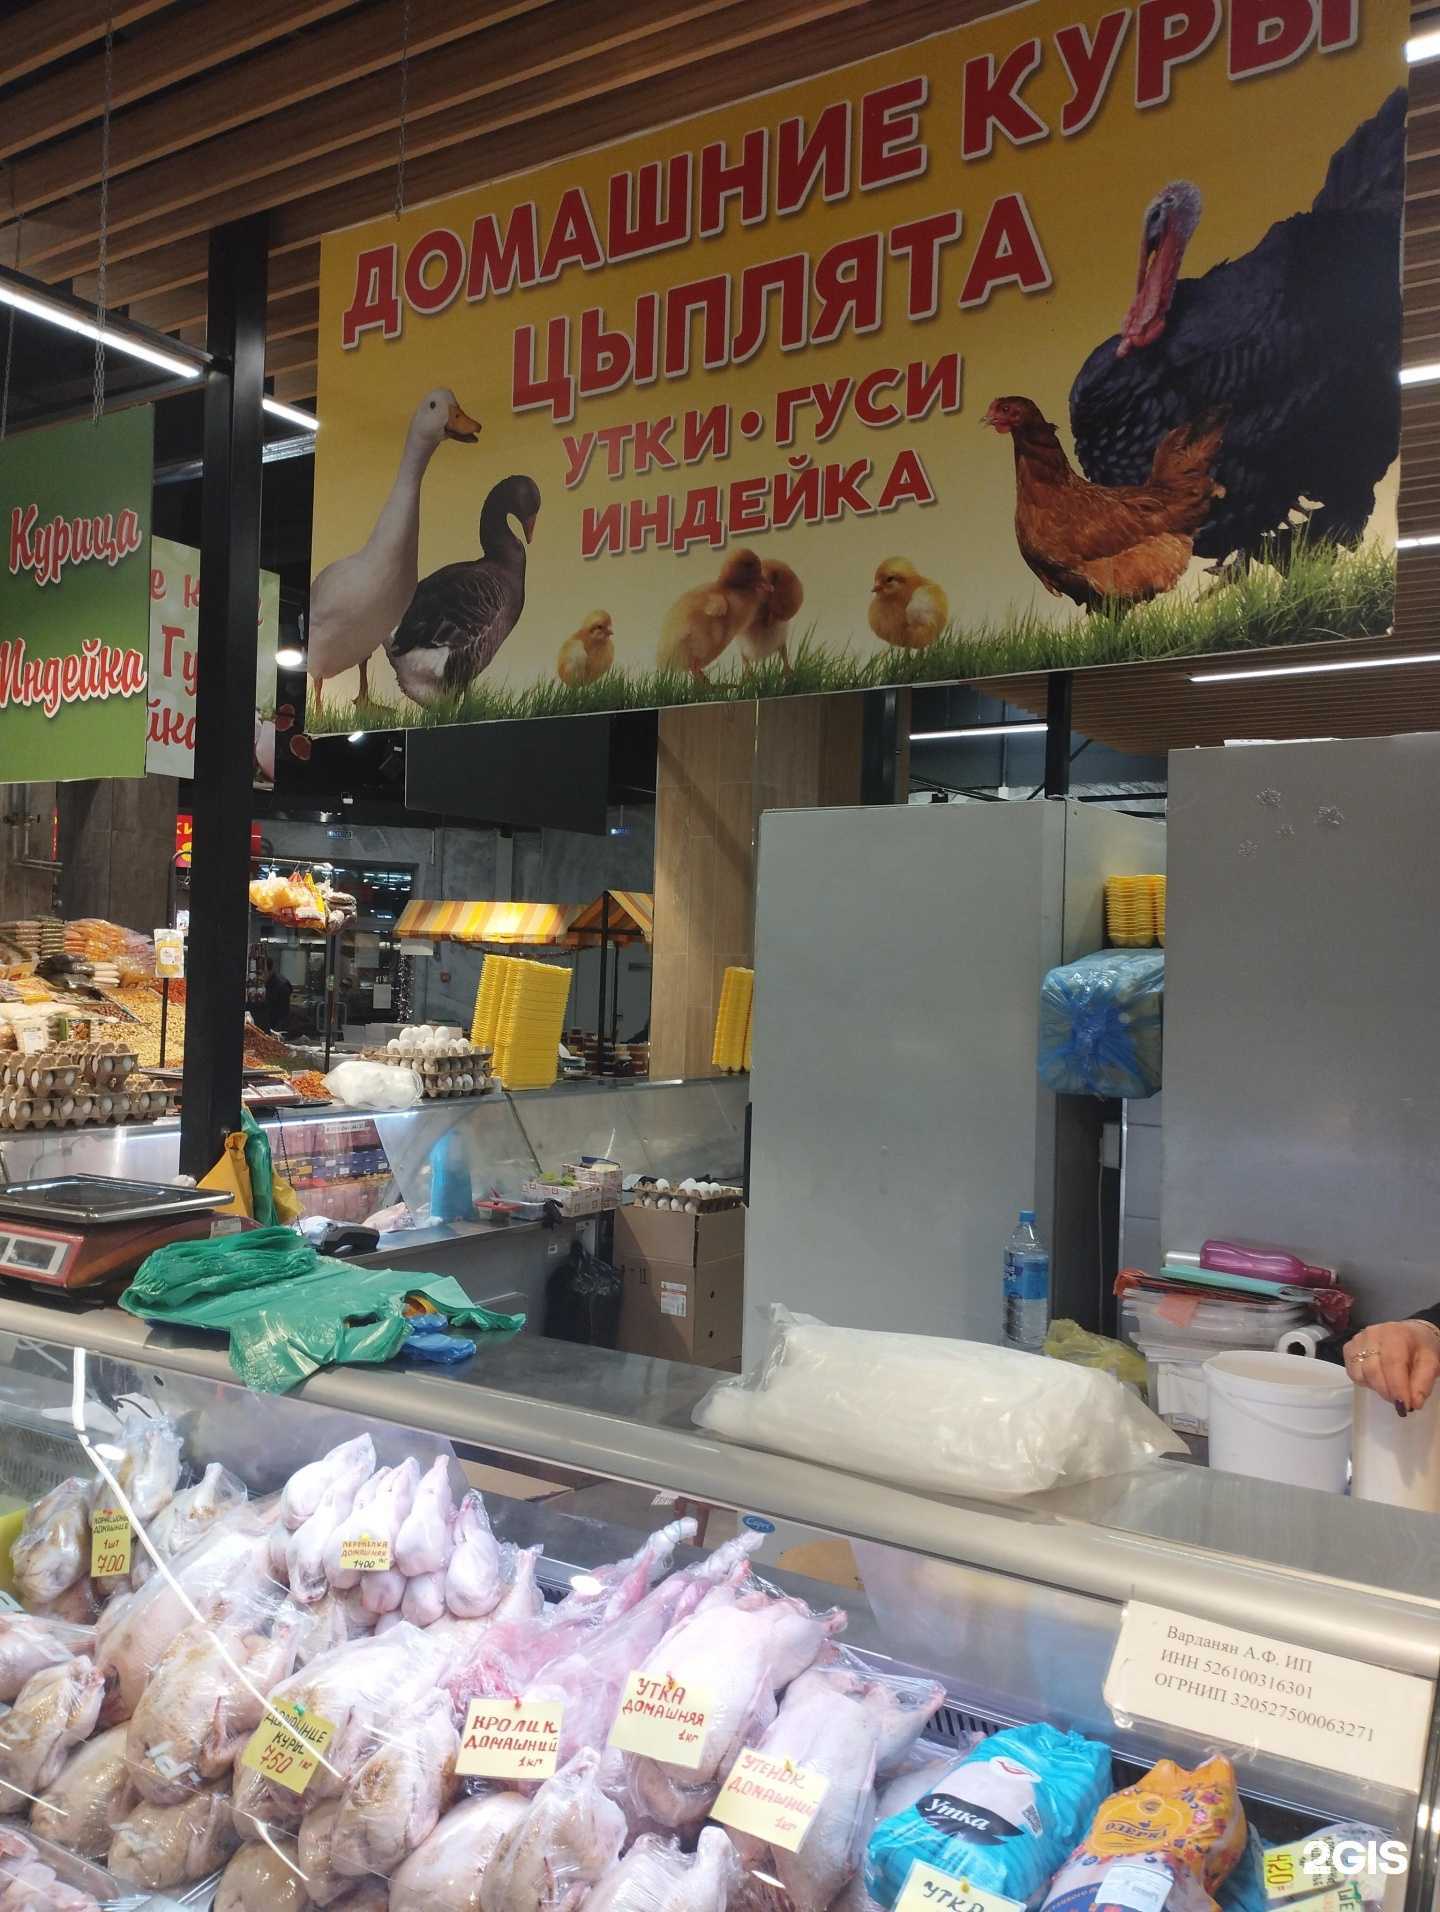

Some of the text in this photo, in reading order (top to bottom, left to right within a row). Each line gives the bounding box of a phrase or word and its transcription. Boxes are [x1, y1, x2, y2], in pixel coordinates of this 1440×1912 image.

[342, 0, 1359, 350] ДОМАШНИЕ КУРЫ
[512, 192, 1052, 423] ЦЫПЛЯТА
[562, 353, 963, 488] УТКИ ГУСИ
[581, 449, 936, 559] ИНДЕЙКА
[9, 504, 142, 586] Курица
[0, 638, 147, 719] Индейка
[98, 1554, 125, 1573] 700
[352, 1559, 376, 1569] 1400
[1167, 1625, 1313, 1674] Варданян А.Ф. ИП
[636, 1677, 686, 1705] УТКА
[1161, 1649, 1313, 1700] ИНН 526100316301
[472, 1715, 558, 1734] КРОЛИК
[622, 1699, 705, 1727] ДОМАШНЯЯ
[1154, 1672, 1375, 1742] ОГРНИП 320527500063271
[260, 1744, 293, 1774] 750
[272, 1731, 304, 1755] КУРЫ
[464, 1735, 559, 1752] ДОМАШНИЙ
[727, 1775, 818, 1818] ДОМАШНИЙ
[924, 1798, 990, 1831] Утка
